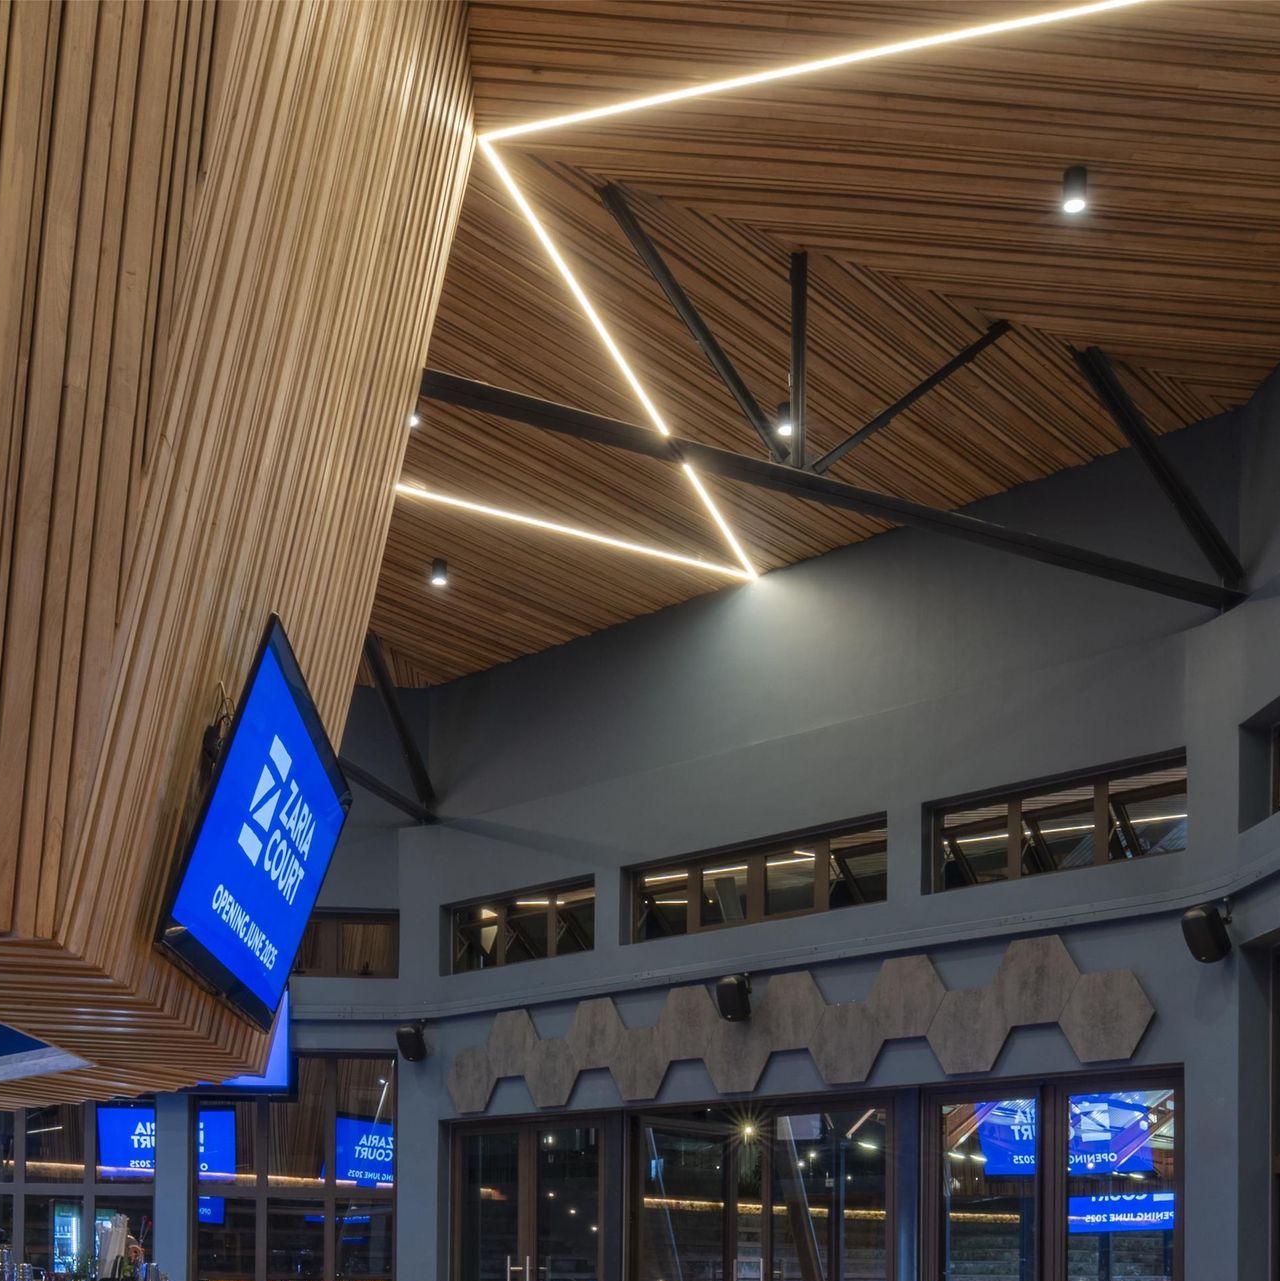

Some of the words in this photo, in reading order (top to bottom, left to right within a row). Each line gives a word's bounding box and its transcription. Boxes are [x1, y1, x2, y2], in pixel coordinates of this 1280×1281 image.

[279, 779, 316, 861] ZARIA
[264, 829, 305, 905] COURT
[212, 884, 250, 938] OPENING
[244, 922, 265, 959] JUNE
[260, 941, 278, 970] 2025
